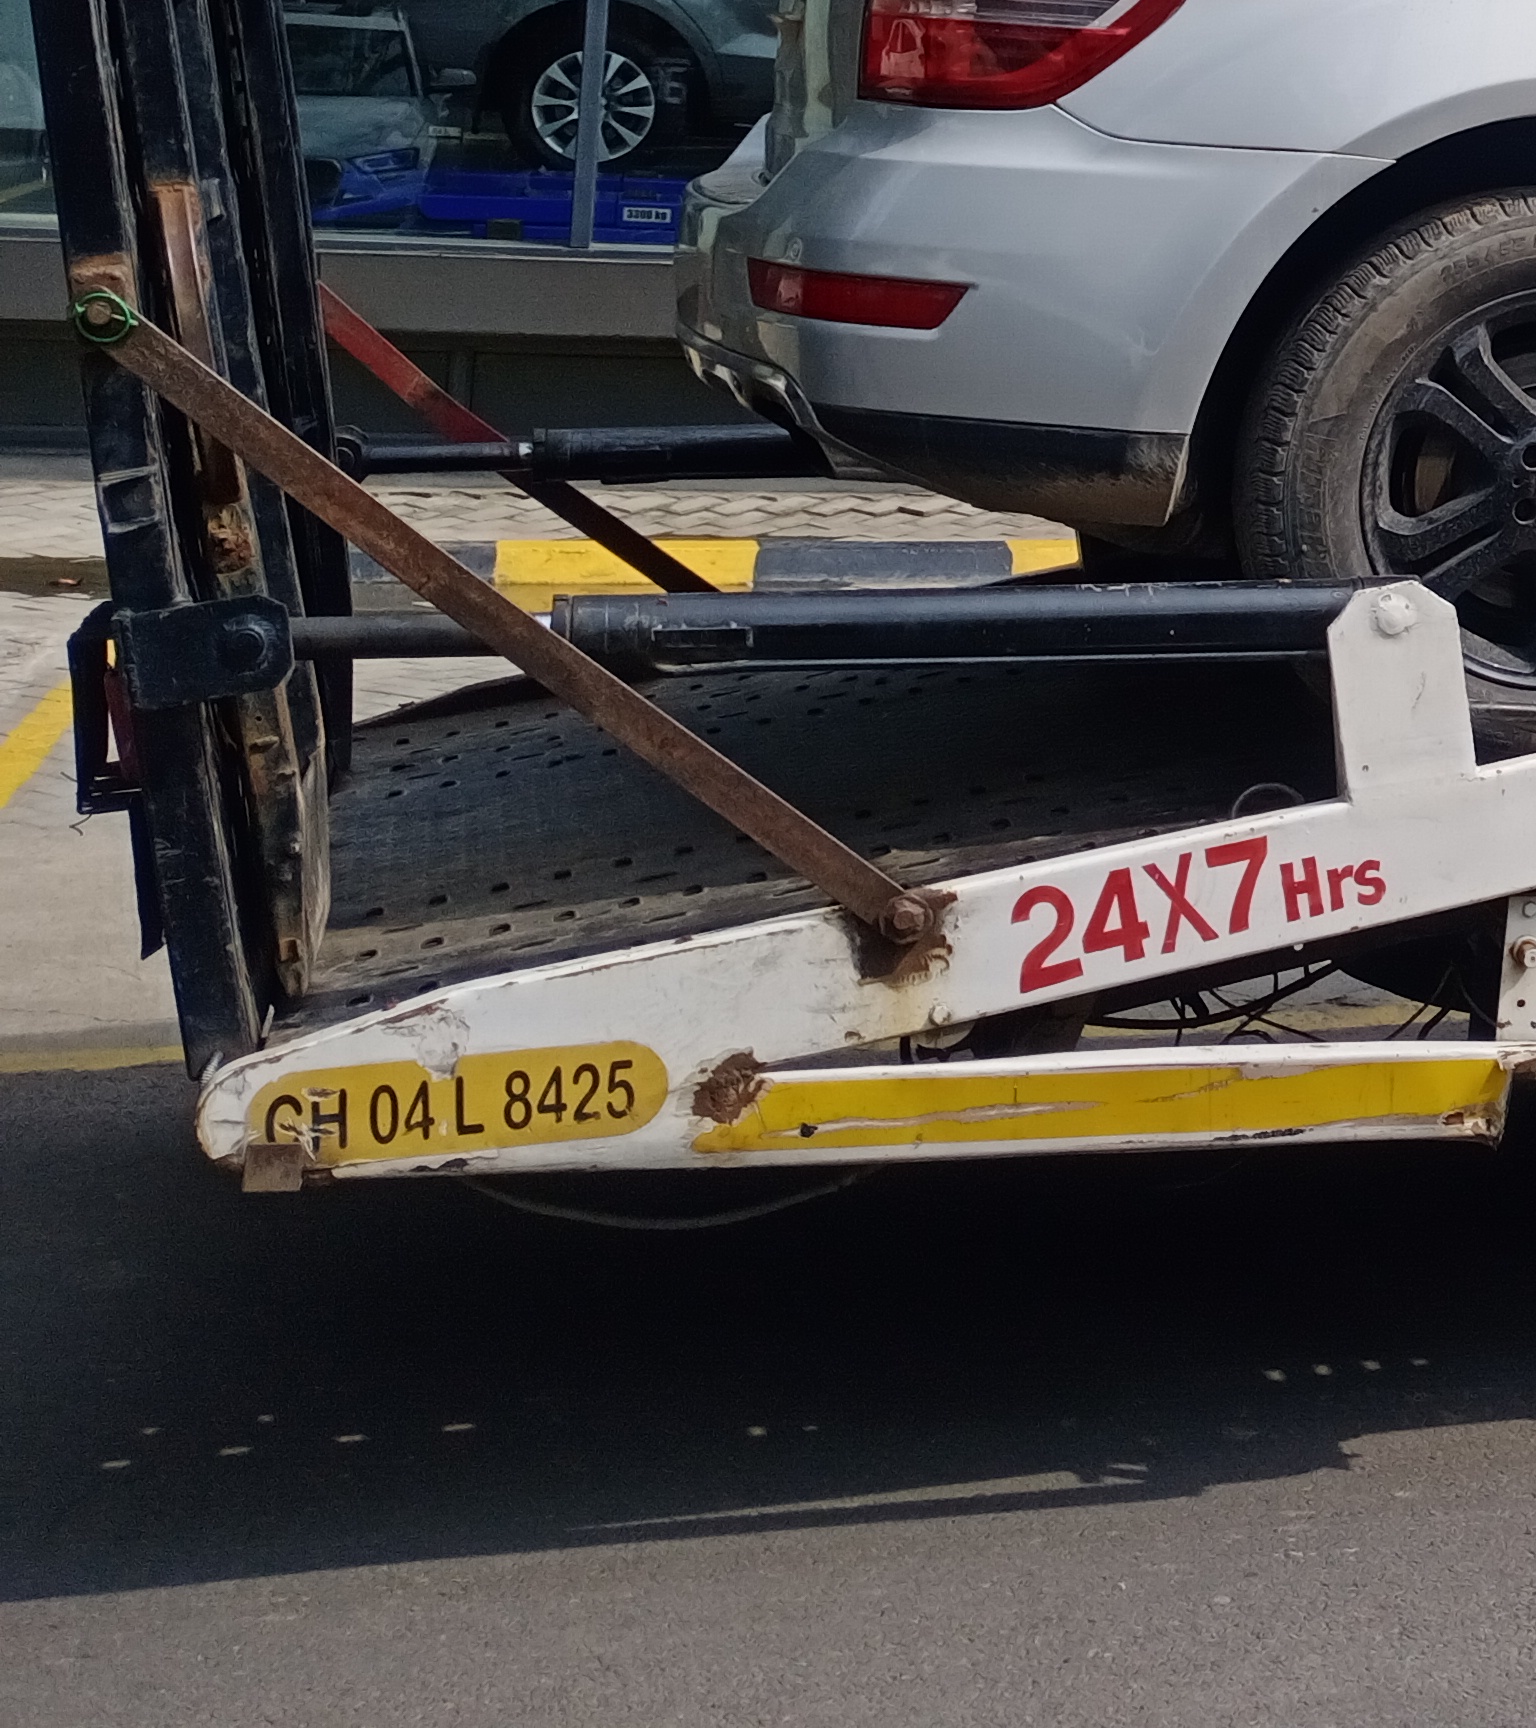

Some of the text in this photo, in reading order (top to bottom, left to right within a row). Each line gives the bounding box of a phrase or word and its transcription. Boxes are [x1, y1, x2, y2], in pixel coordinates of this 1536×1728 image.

[1011, 835, 1387, 994] 24X7 Hrs
[369, 1079, 435, 1146] 04
[455, 1076, 485, 1136] L
[502, 1060, 636, 1132] 8425
